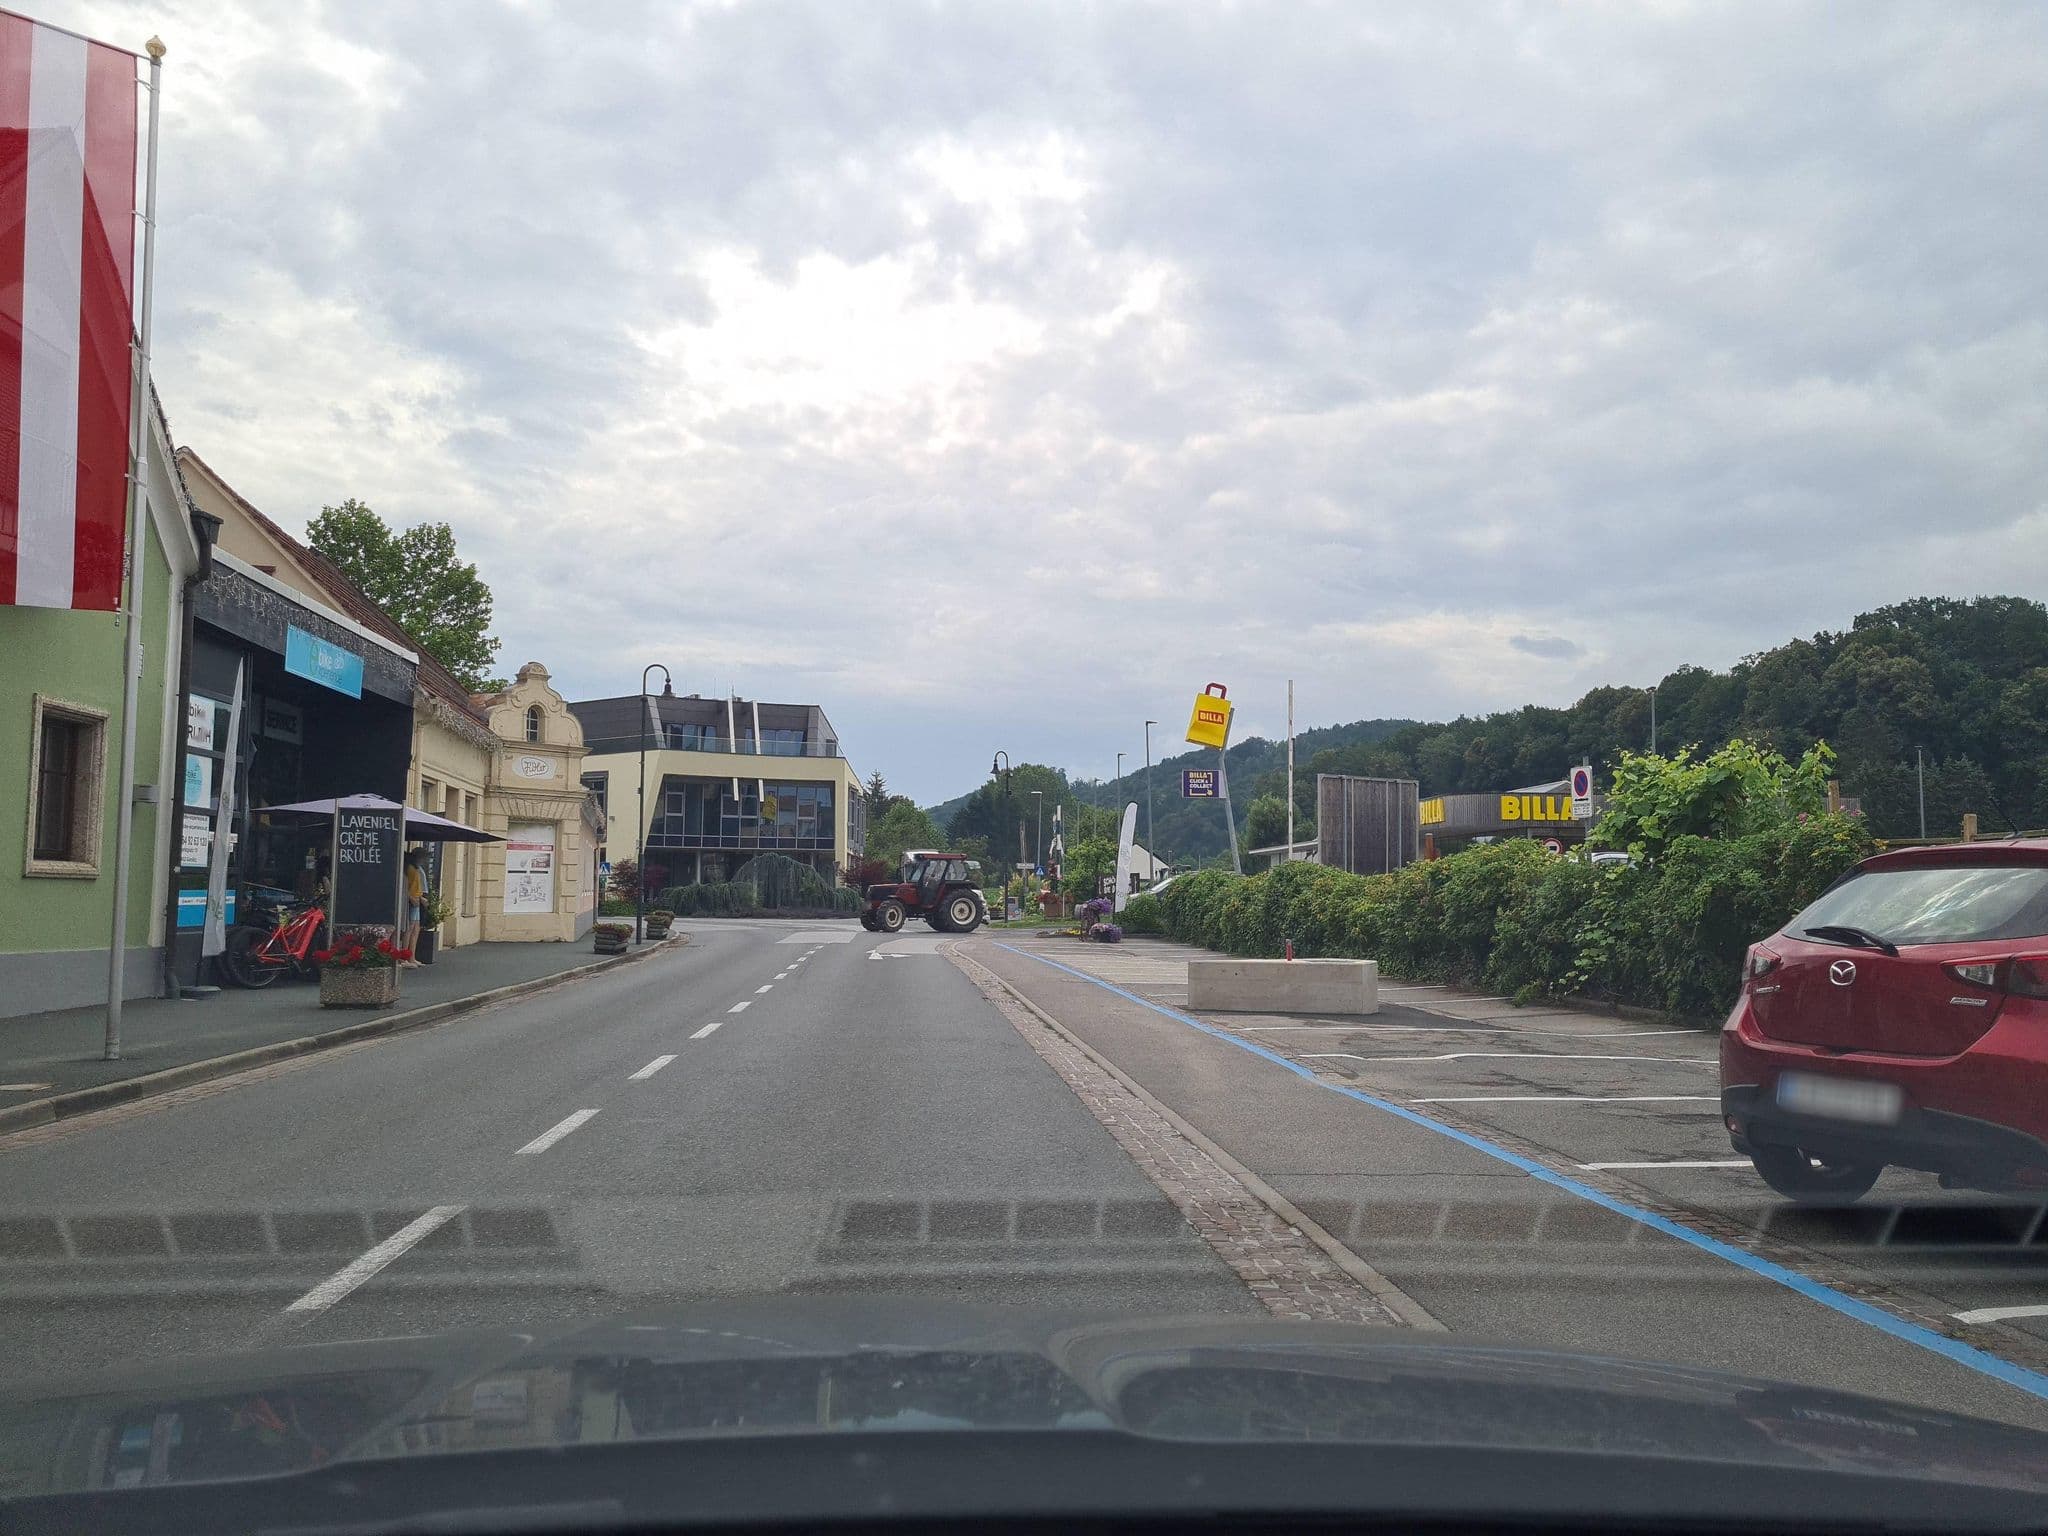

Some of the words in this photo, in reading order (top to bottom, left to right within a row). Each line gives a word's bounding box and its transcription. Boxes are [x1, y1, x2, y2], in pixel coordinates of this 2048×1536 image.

[1199, 711, 1223, 723] BILLA
[1419, 798, 1445, 825] BILLA
[1501, 795, 1579, 821] BILLA
[341, 815, 399, 831] LAVENDEL
[340, 829, 380, 846] CRÈME
